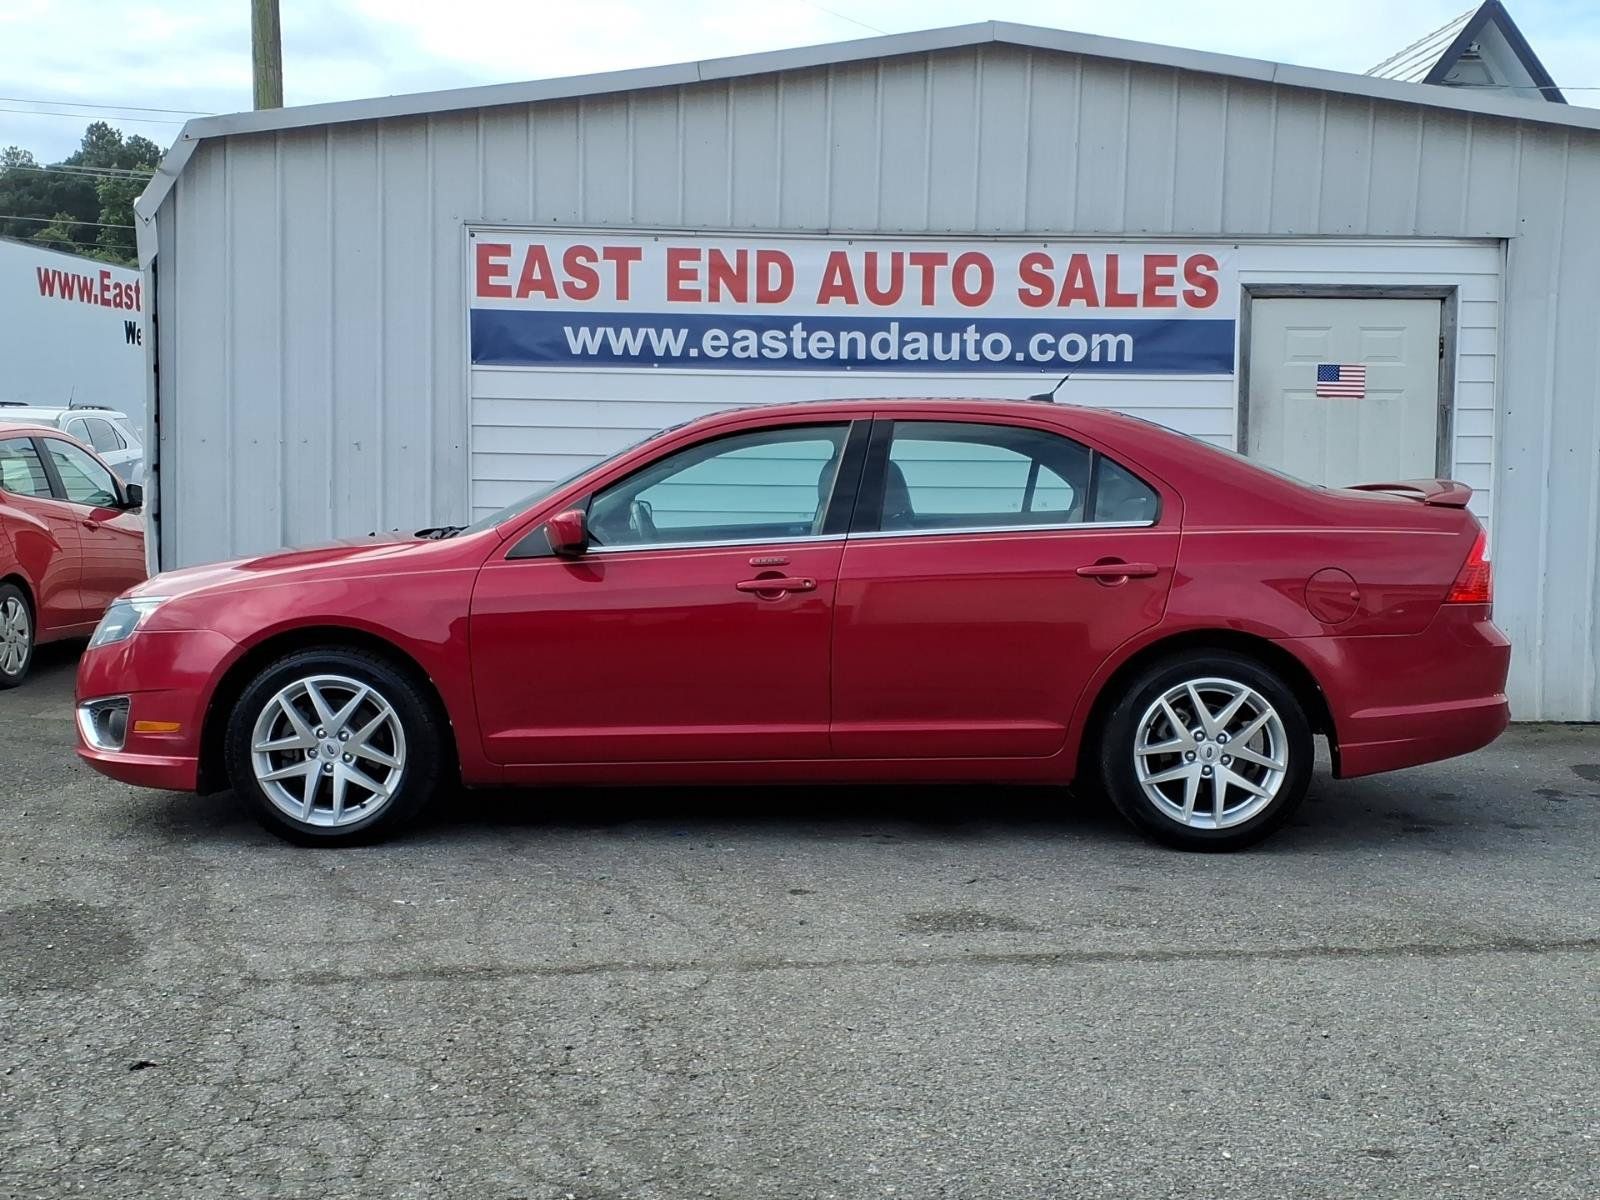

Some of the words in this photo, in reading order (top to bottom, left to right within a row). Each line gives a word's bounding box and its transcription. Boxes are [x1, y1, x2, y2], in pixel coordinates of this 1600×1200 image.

[476, 243, 643, 301] EAST
[666, 247, 796, 304] END
[815, 250, 995, 308] AUTO
[1017, 252, 1220, 309] SALES
[563, 321, 1134, 363] www.eastendauto.com
